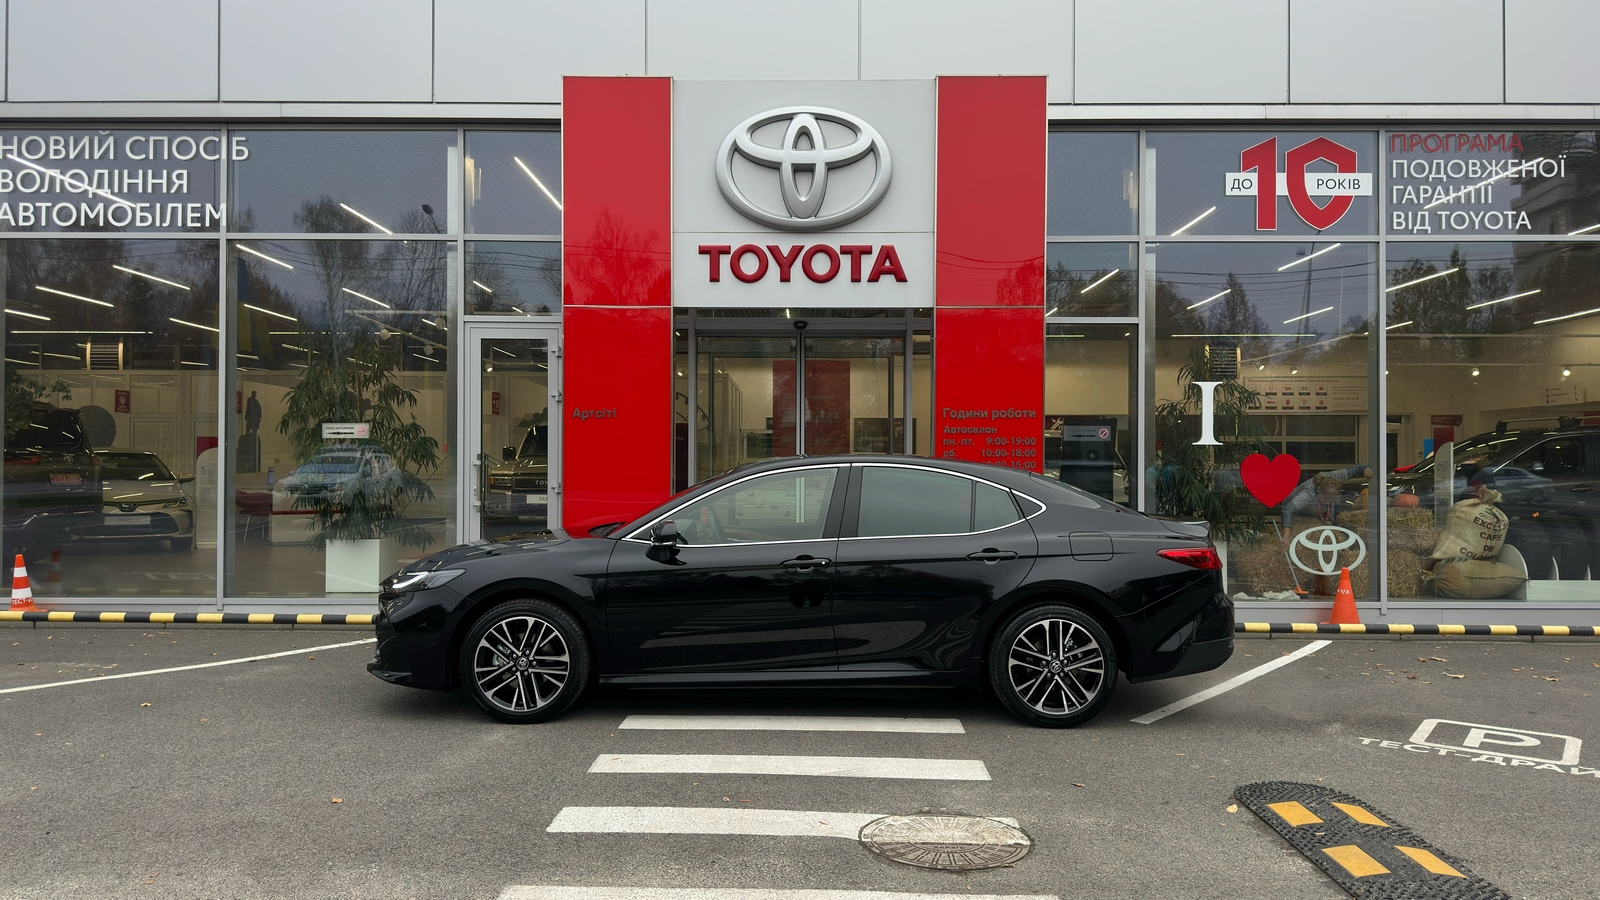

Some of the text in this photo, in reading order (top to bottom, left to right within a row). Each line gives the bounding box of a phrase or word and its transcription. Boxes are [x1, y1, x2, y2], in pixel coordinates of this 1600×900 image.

[0, 130, 249, 160] НОВИЙ СПОСІБ
[1391, 133, 1524, 152] ПРОГРАМА
[1392, 154, 1567, 182] ПОДОВЖЕНОЇ
[0, 168, 188, 199] ВОЛОДІННЯ
[1231, 135, 1361, 231] ДО 10 РОКІВ
[1392, 181, 1493, 204] ГАРАНТІЇ
[0, 202, 227, 227] АВТОМОБІЛЕМ
[1392, 211, 1532, 234] ВІД TOYOTA
[698, 243, 908, 284] TOYOTA
[572, 407, 617, 421] Артсіті
[943, 407, 1036, 421] Години роботи
[1191, 381, 1224, 446] I
[943, 425, 998, 434] Автосалон
[943, 437, 1036, 446] пн.-пт. 9:00-19:00
[943, 448, 1036, 457] сб. 10:00-18:00
[1482, 544, 1496, 553] DE
